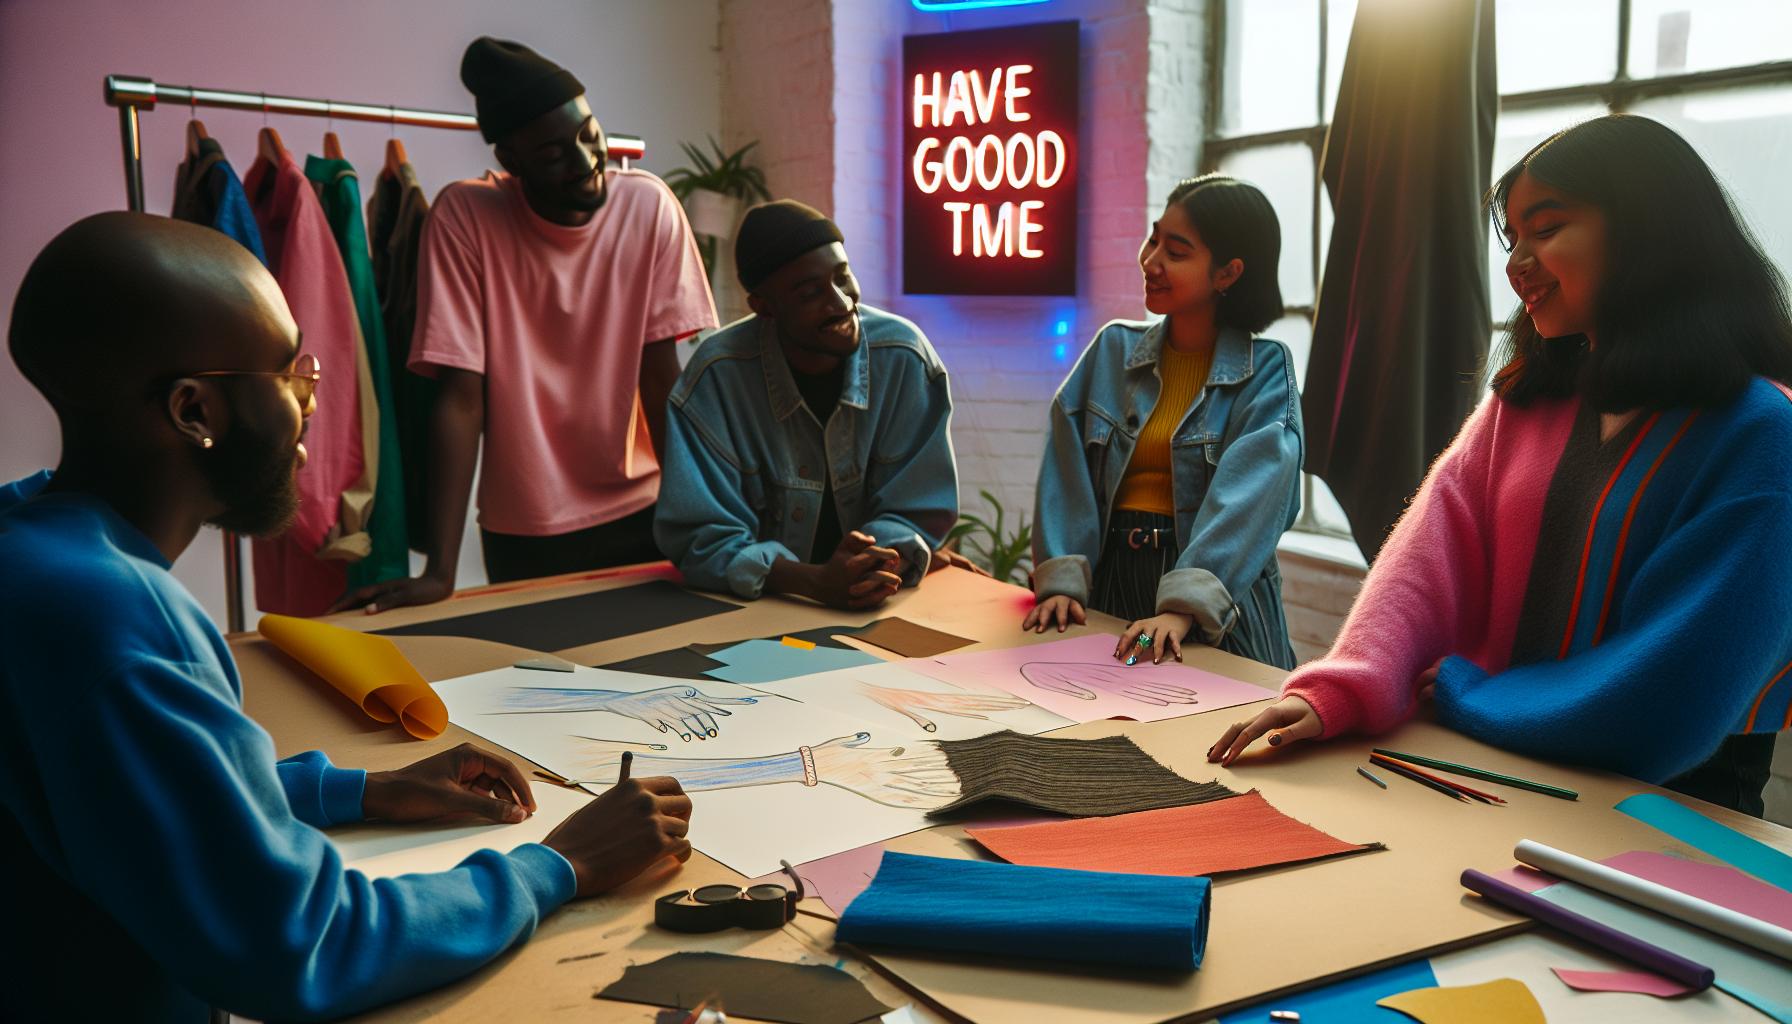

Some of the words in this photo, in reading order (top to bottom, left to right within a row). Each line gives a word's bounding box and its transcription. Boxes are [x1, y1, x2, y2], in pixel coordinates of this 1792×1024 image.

[913, 65, 1034, 128] HAVE
[913, 130, 1066, 194] GOOOD
[943, 200, 1045, 258] TME
